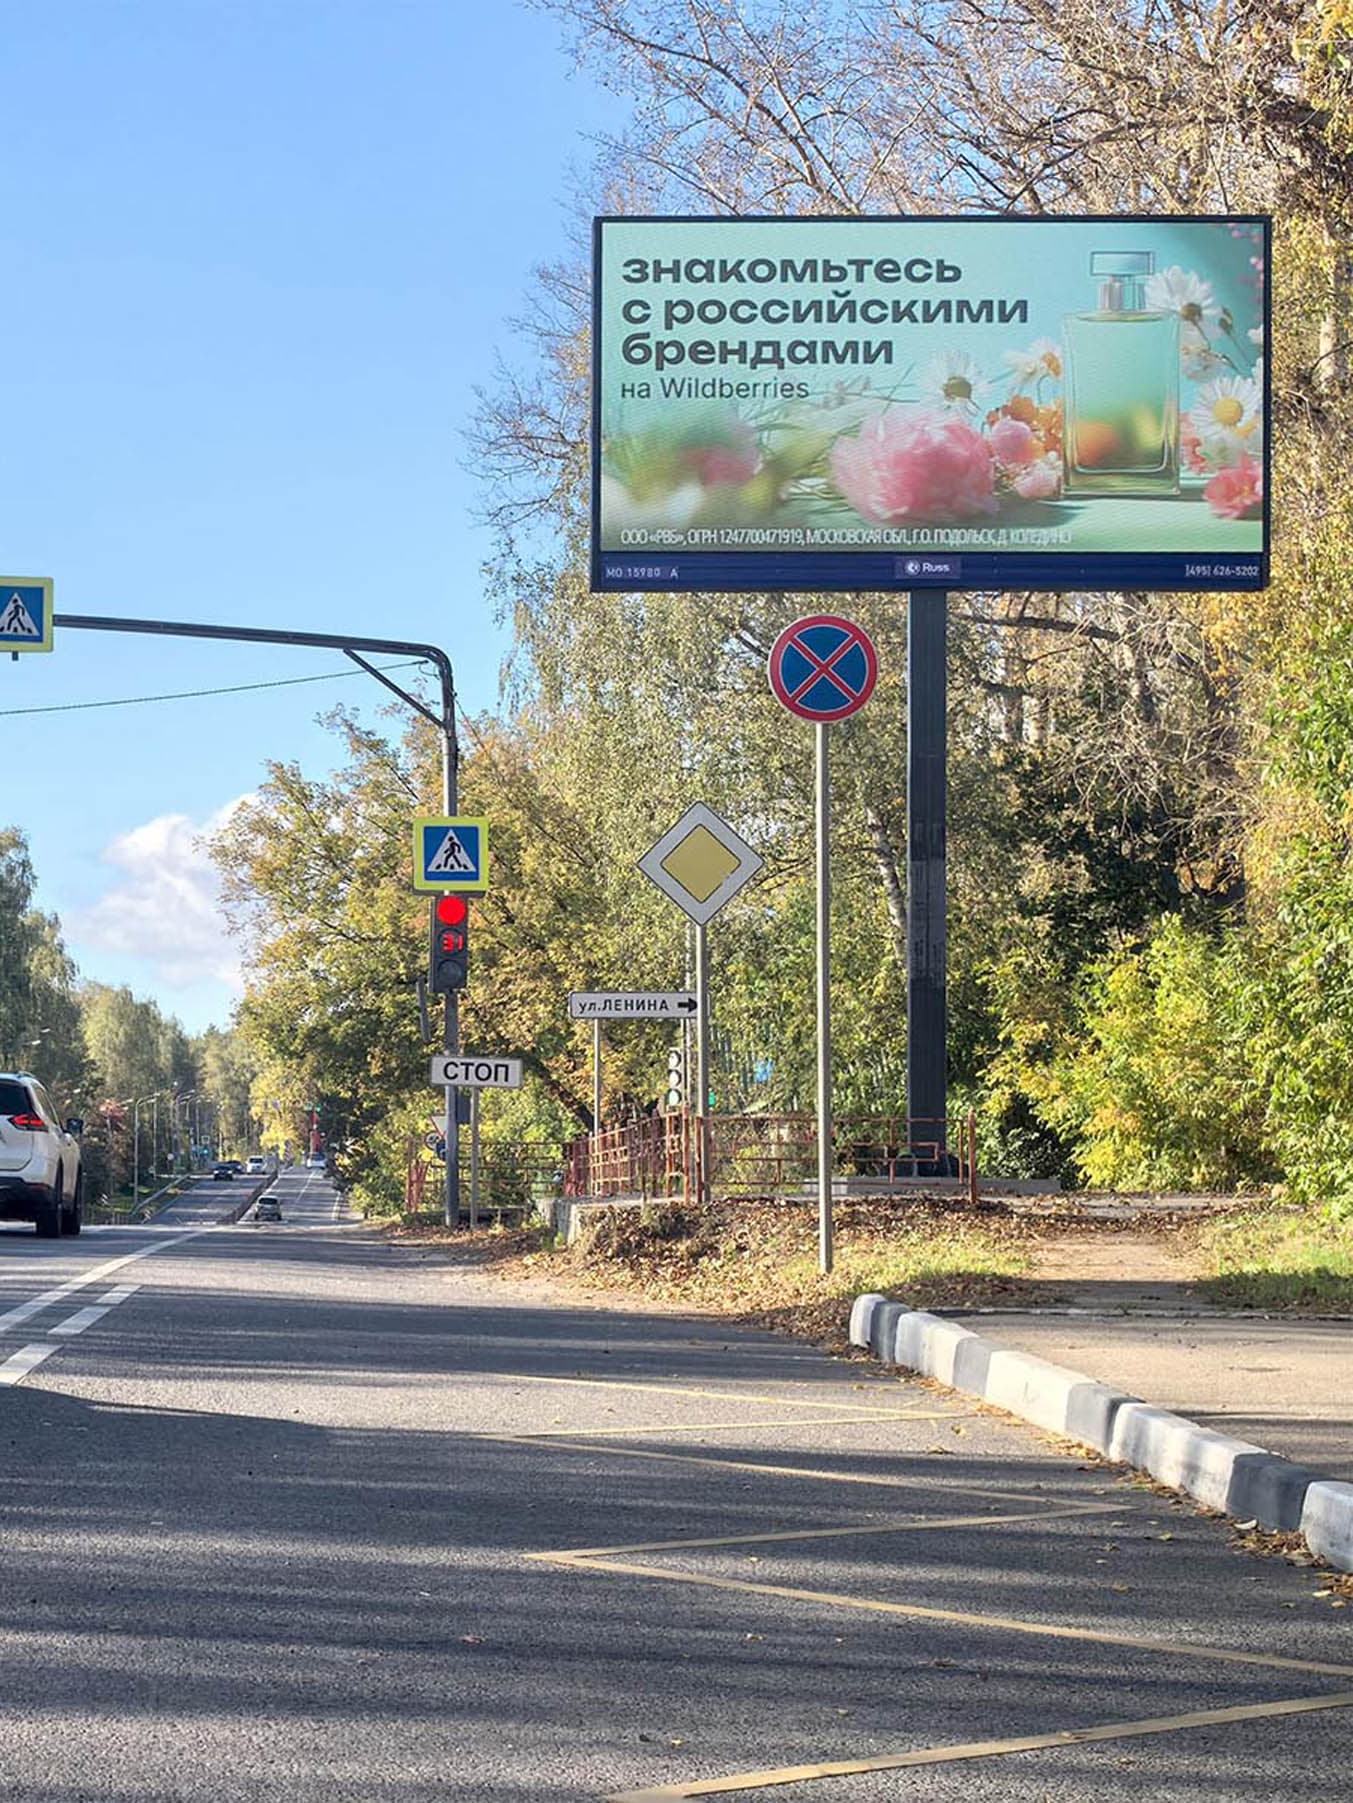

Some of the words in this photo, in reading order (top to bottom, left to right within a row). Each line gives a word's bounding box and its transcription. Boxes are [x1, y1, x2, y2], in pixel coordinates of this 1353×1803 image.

[622, 258, 962, 283] знакомьтесь
[622, 299, 651, 324] с
[664, 290, 1029, 330] российскими
[622, 333, 894, 371] брендами
[621, 384, 650, 399] на
[660, 377, 810, 400] Wildberries
[621, 528, 648, 544] ООО
[922, 563, 950, 573] Russ
[441, 934, 463, 951] 31
[443, 1061, 509, 1083] СТОП
